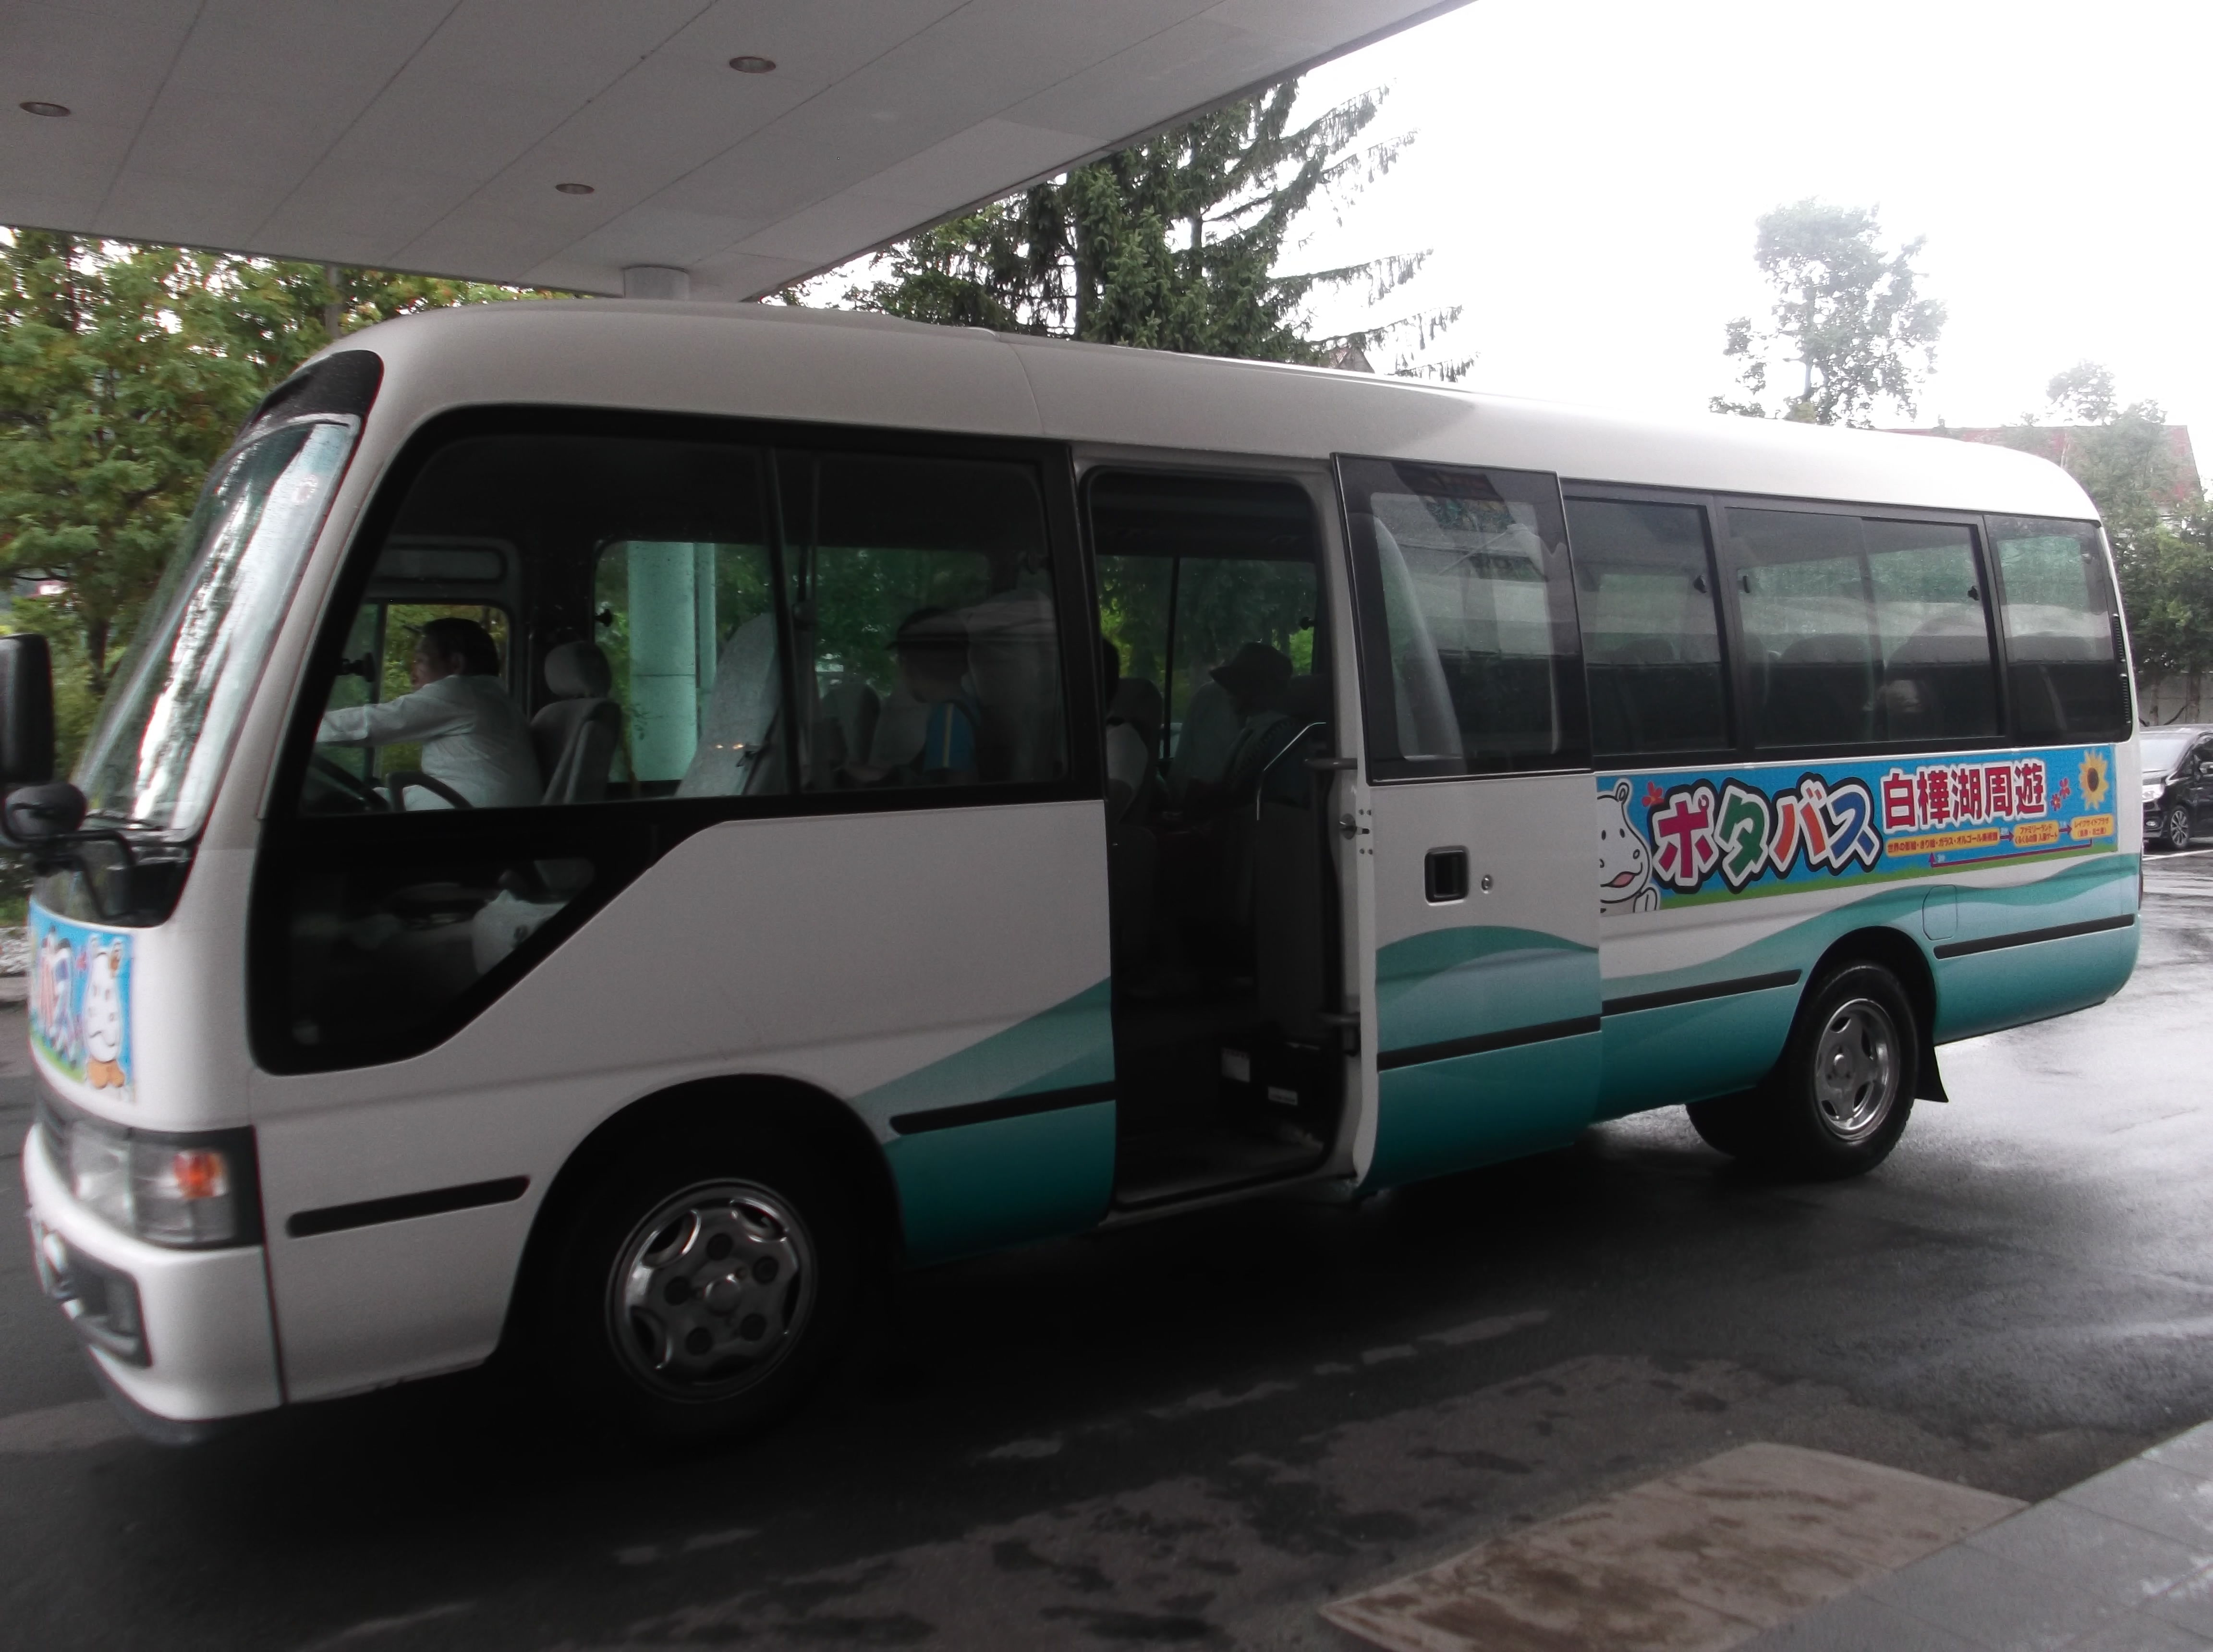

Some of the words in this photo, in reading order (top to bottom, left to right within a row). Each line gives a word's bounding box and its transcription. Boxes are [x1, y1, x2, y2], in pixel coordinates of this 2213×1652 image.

[1652, 779, 1880, 887] ポタバス
[1882, 762, 2045, 830] 白樺湖周遊
